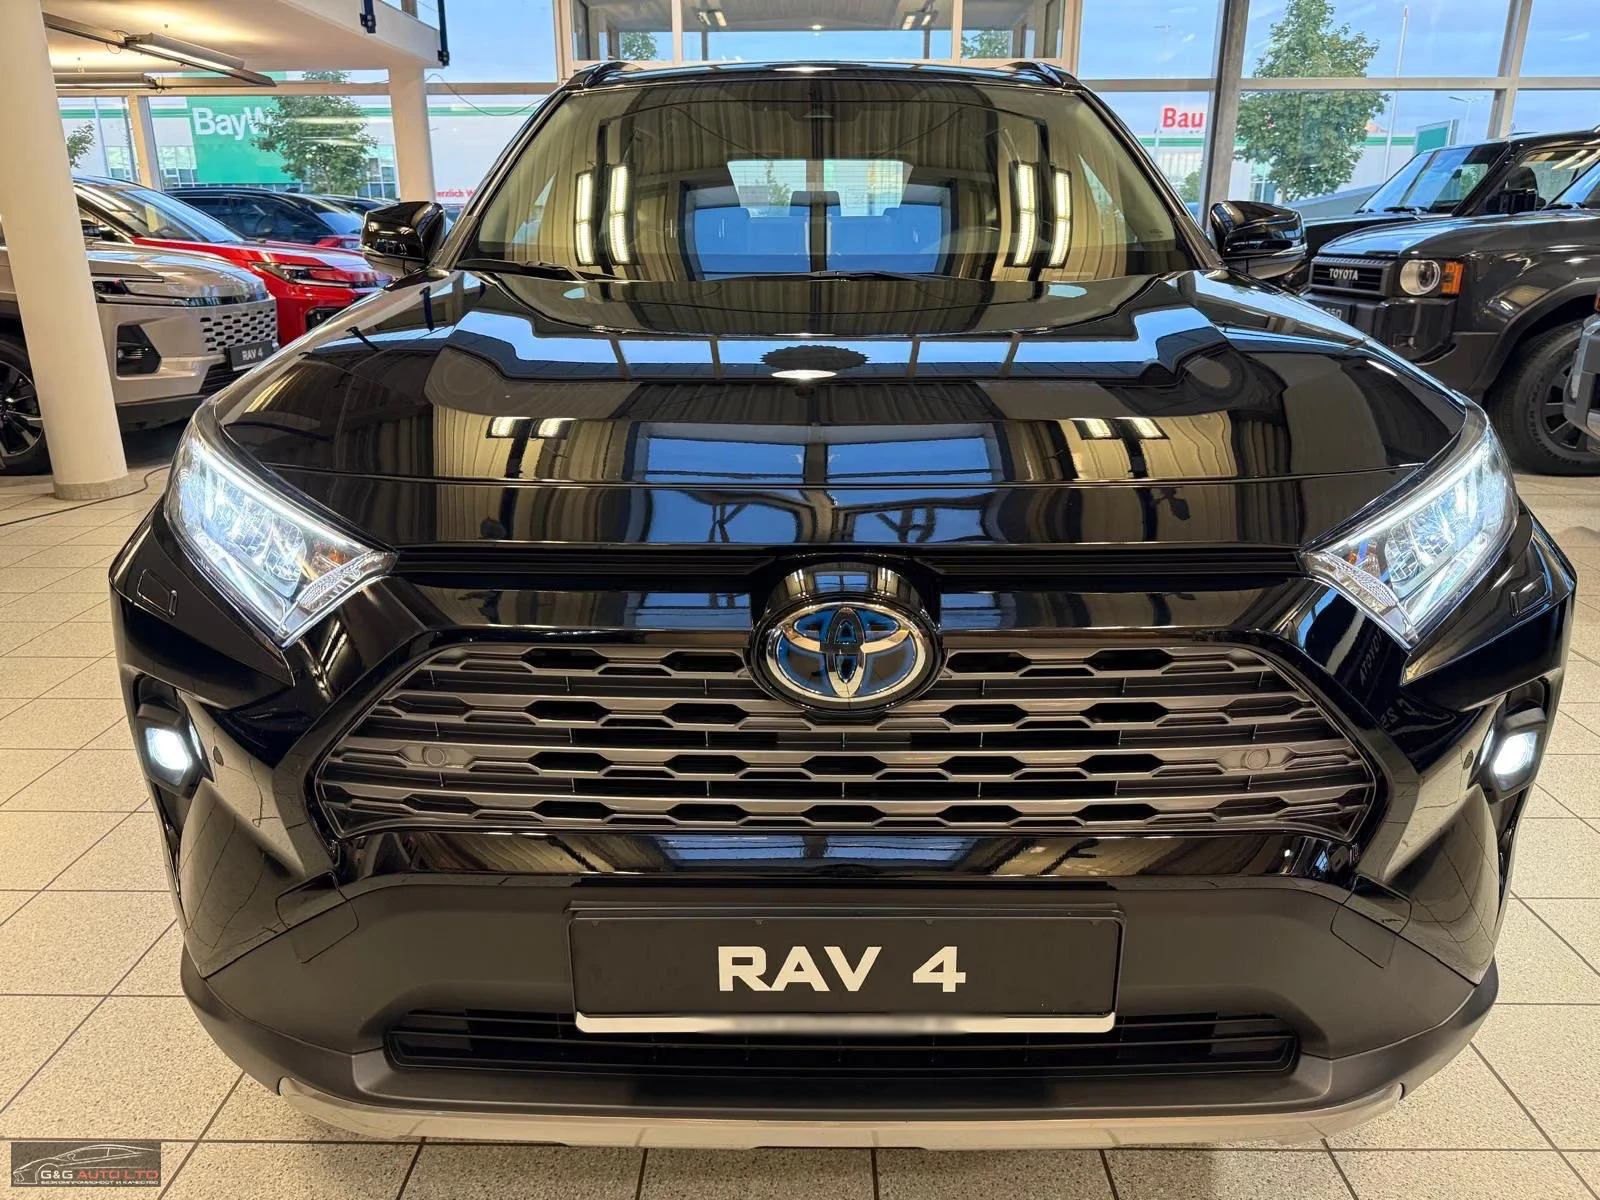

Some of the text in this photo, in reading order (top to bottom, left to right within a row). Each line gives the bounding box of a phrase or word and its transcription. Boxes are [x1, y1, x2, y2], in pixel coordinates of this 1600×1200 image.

[1162, 107, 1204, 128] Bau
[1329, 268, 1359, 281] TOYOTA
[241, 347, 264, 361] RAV 4
[718, 946, 966, 992] RAV 4
